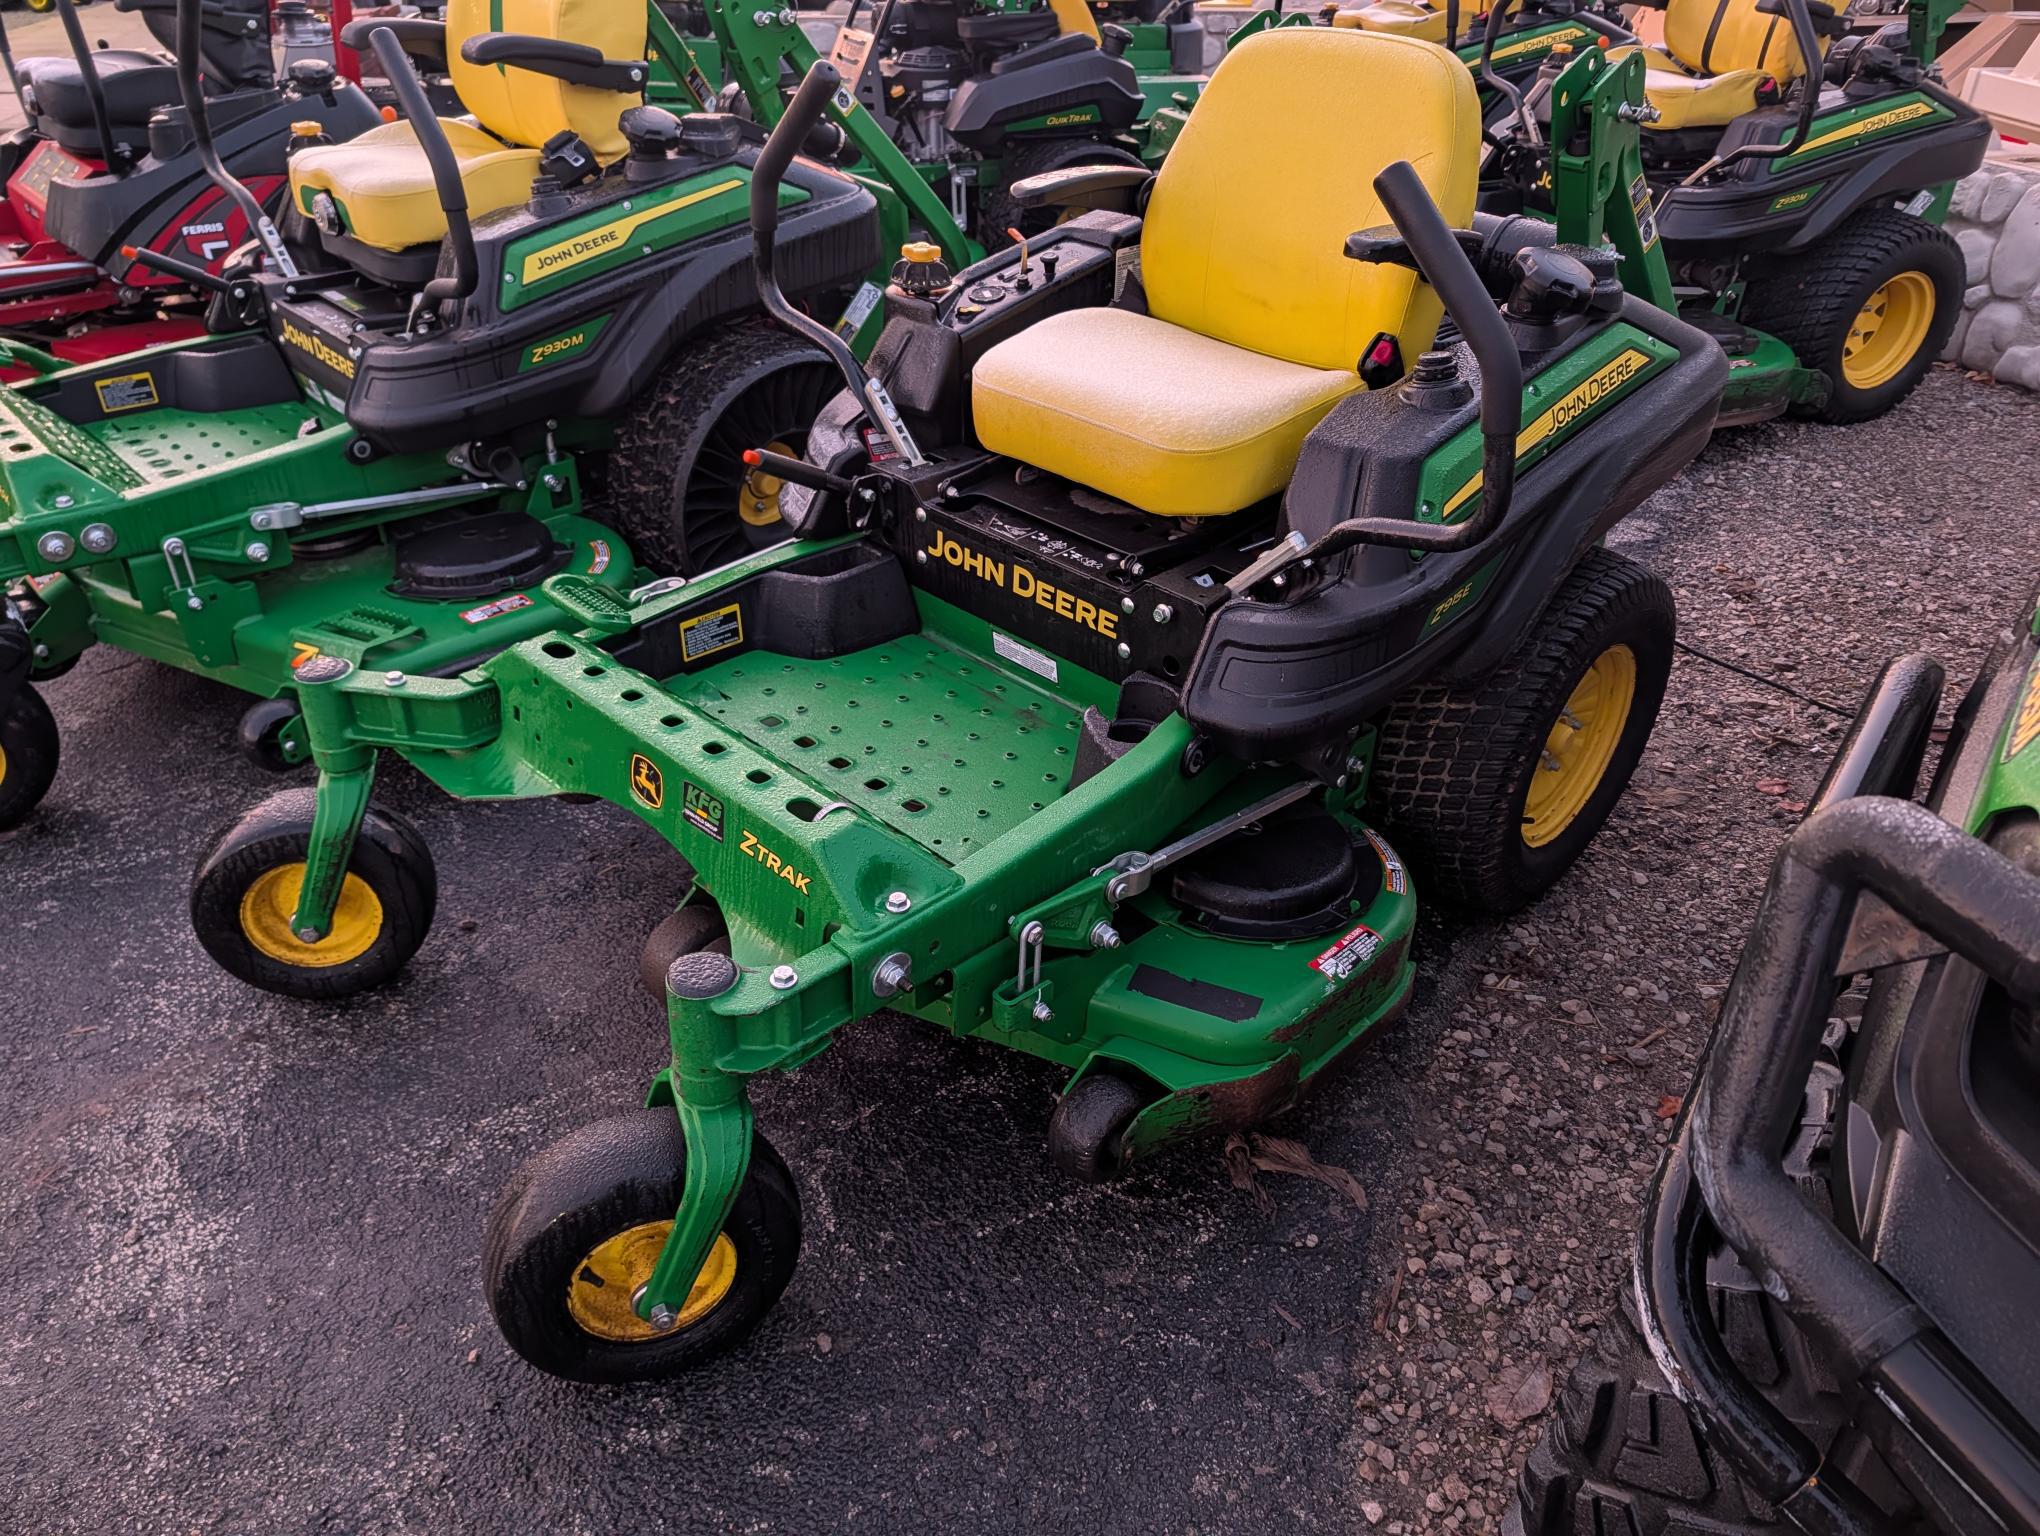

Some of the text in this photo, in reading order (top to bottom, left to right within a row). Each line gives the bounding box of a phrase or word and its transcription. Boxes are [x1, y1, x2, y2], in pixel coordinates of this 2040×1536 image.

[1522, 31, 1577, 52] JOHN DEERE
[1860, 106, 1922, 133] JOHN DEERE
[181, 222, 225, 236] FERRIS
[537, 230, 619, 270] JOHN DEERE
[282, 318, 315, 355] JOHN
[312, 336, 355, 379] DEERE
[531, 333, 584, 363] Z930M
[1548, 356, 1634, 434] JOHN DEERE
[927, 529, 1005, 588] JOHN
[1012, 564, 1119, 640] DEERE
[686, 784, 723, 820] KFG
[739, 829, 812, 896] ZTRAK
